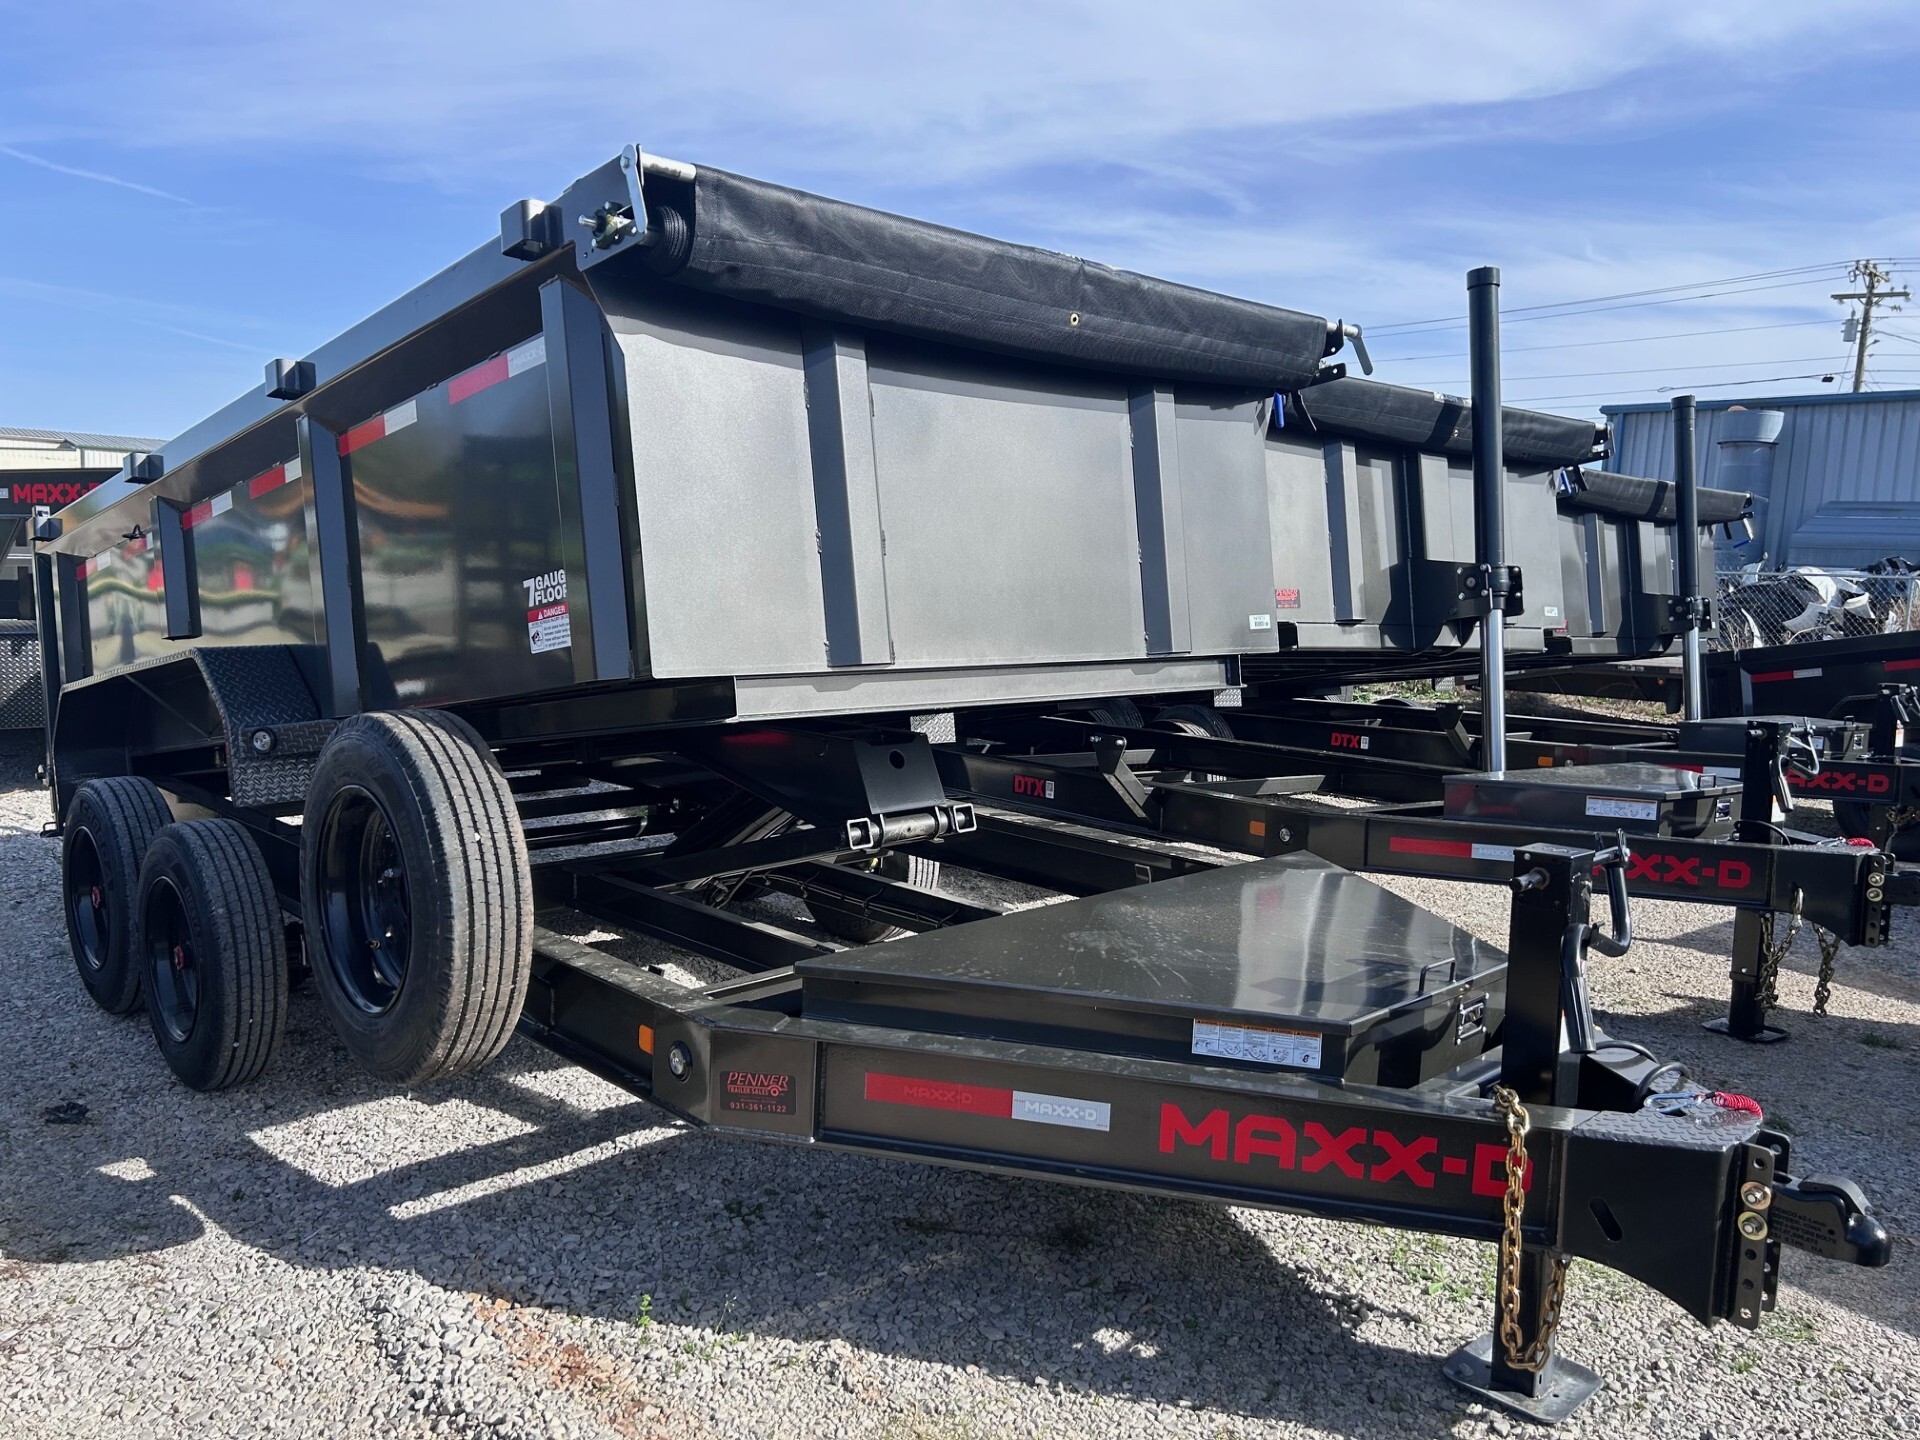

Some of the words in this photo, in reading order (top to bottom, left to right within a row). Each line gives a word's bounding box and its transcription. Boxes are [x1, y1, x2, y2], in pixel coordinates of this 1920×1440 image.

[523, 578, 535, 607] 7
[544, 605, 566, 618] DANGER
[1331, 733, 1360, 748] DTX
[1014, 775, 1045, 797] DTX
[727, 1072, 789, 1088] PENNER
[728, 1085, 750, 1094] TRAILER
[903, 1085, 973, 1104] MAXX-D
[730, 1102, 787, 1112] 931-361-1122
[1025, 1100, 1097, 1121] MAXX-D
[1159, 1103, 1533, 1198] MAXX-D
